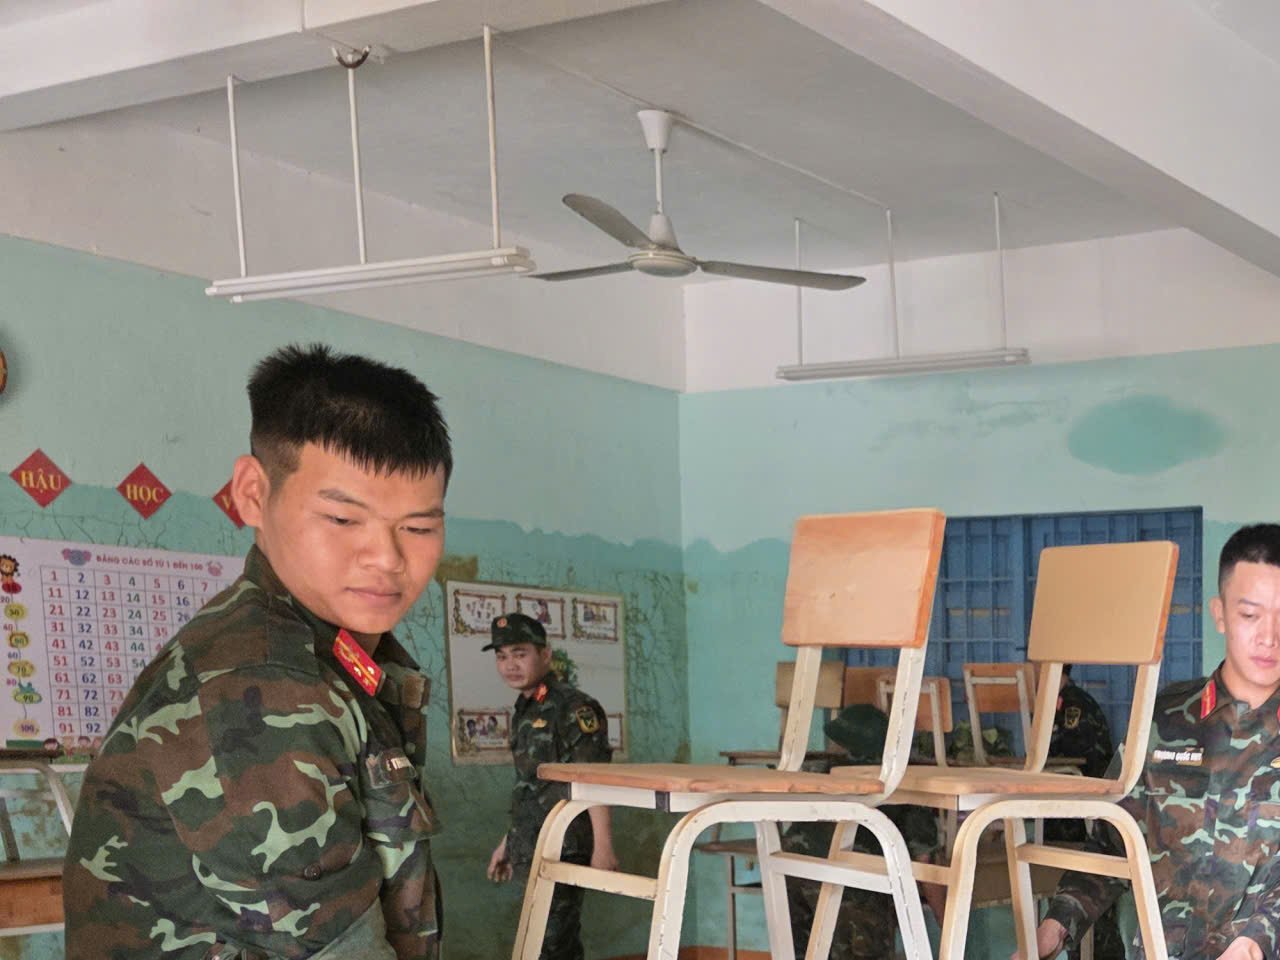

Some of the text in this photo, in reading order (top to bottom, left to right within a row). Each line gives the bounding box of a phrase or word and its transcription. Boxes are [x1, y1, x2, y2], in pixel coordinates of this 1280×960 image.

[20, 468, 62, 493] HẬU
[126, 483, 164, 505] HỌC
[51, 570, 208, 593] 1 2 3 4 5 6 7
[48, 587, 62, 598] 11
[76, 590, 90, 600] 12
[102, 591, 115, 601] 13
[127, 592, 140, 603] 14
[152, 594, 165, 605] 15
[176, 595, 190, 607] 16
[49, 604, 64, 616] 21
[76, 606, 91, 617] 22
[103, 607, 117, 618] 23
[128, 609, 142, 620] 24
[152, 611, 166, 621] 25
[50, 622, 65, 632] 31
[78, 623, 92, 633] 32
[104, 624, 118, 635] 33
[129, 626, 143, 636] 34
[52, 639, 66, 649] 41
[79, 640, 93, 650] 42
[105, 641, 119, 652] 43
[131, 642, 145, 652] 44
[53, 656, 146, 668] 51 52 53 54
[55, 673, 122, 684] 61 62 63
[56, 689, 70, 700] 71
[83, 690, 97, 700] 72
[57, 706, 72, 717] 81
[85, 706, 99, 717] 82
[59, 723, 101, 733] 91 92
